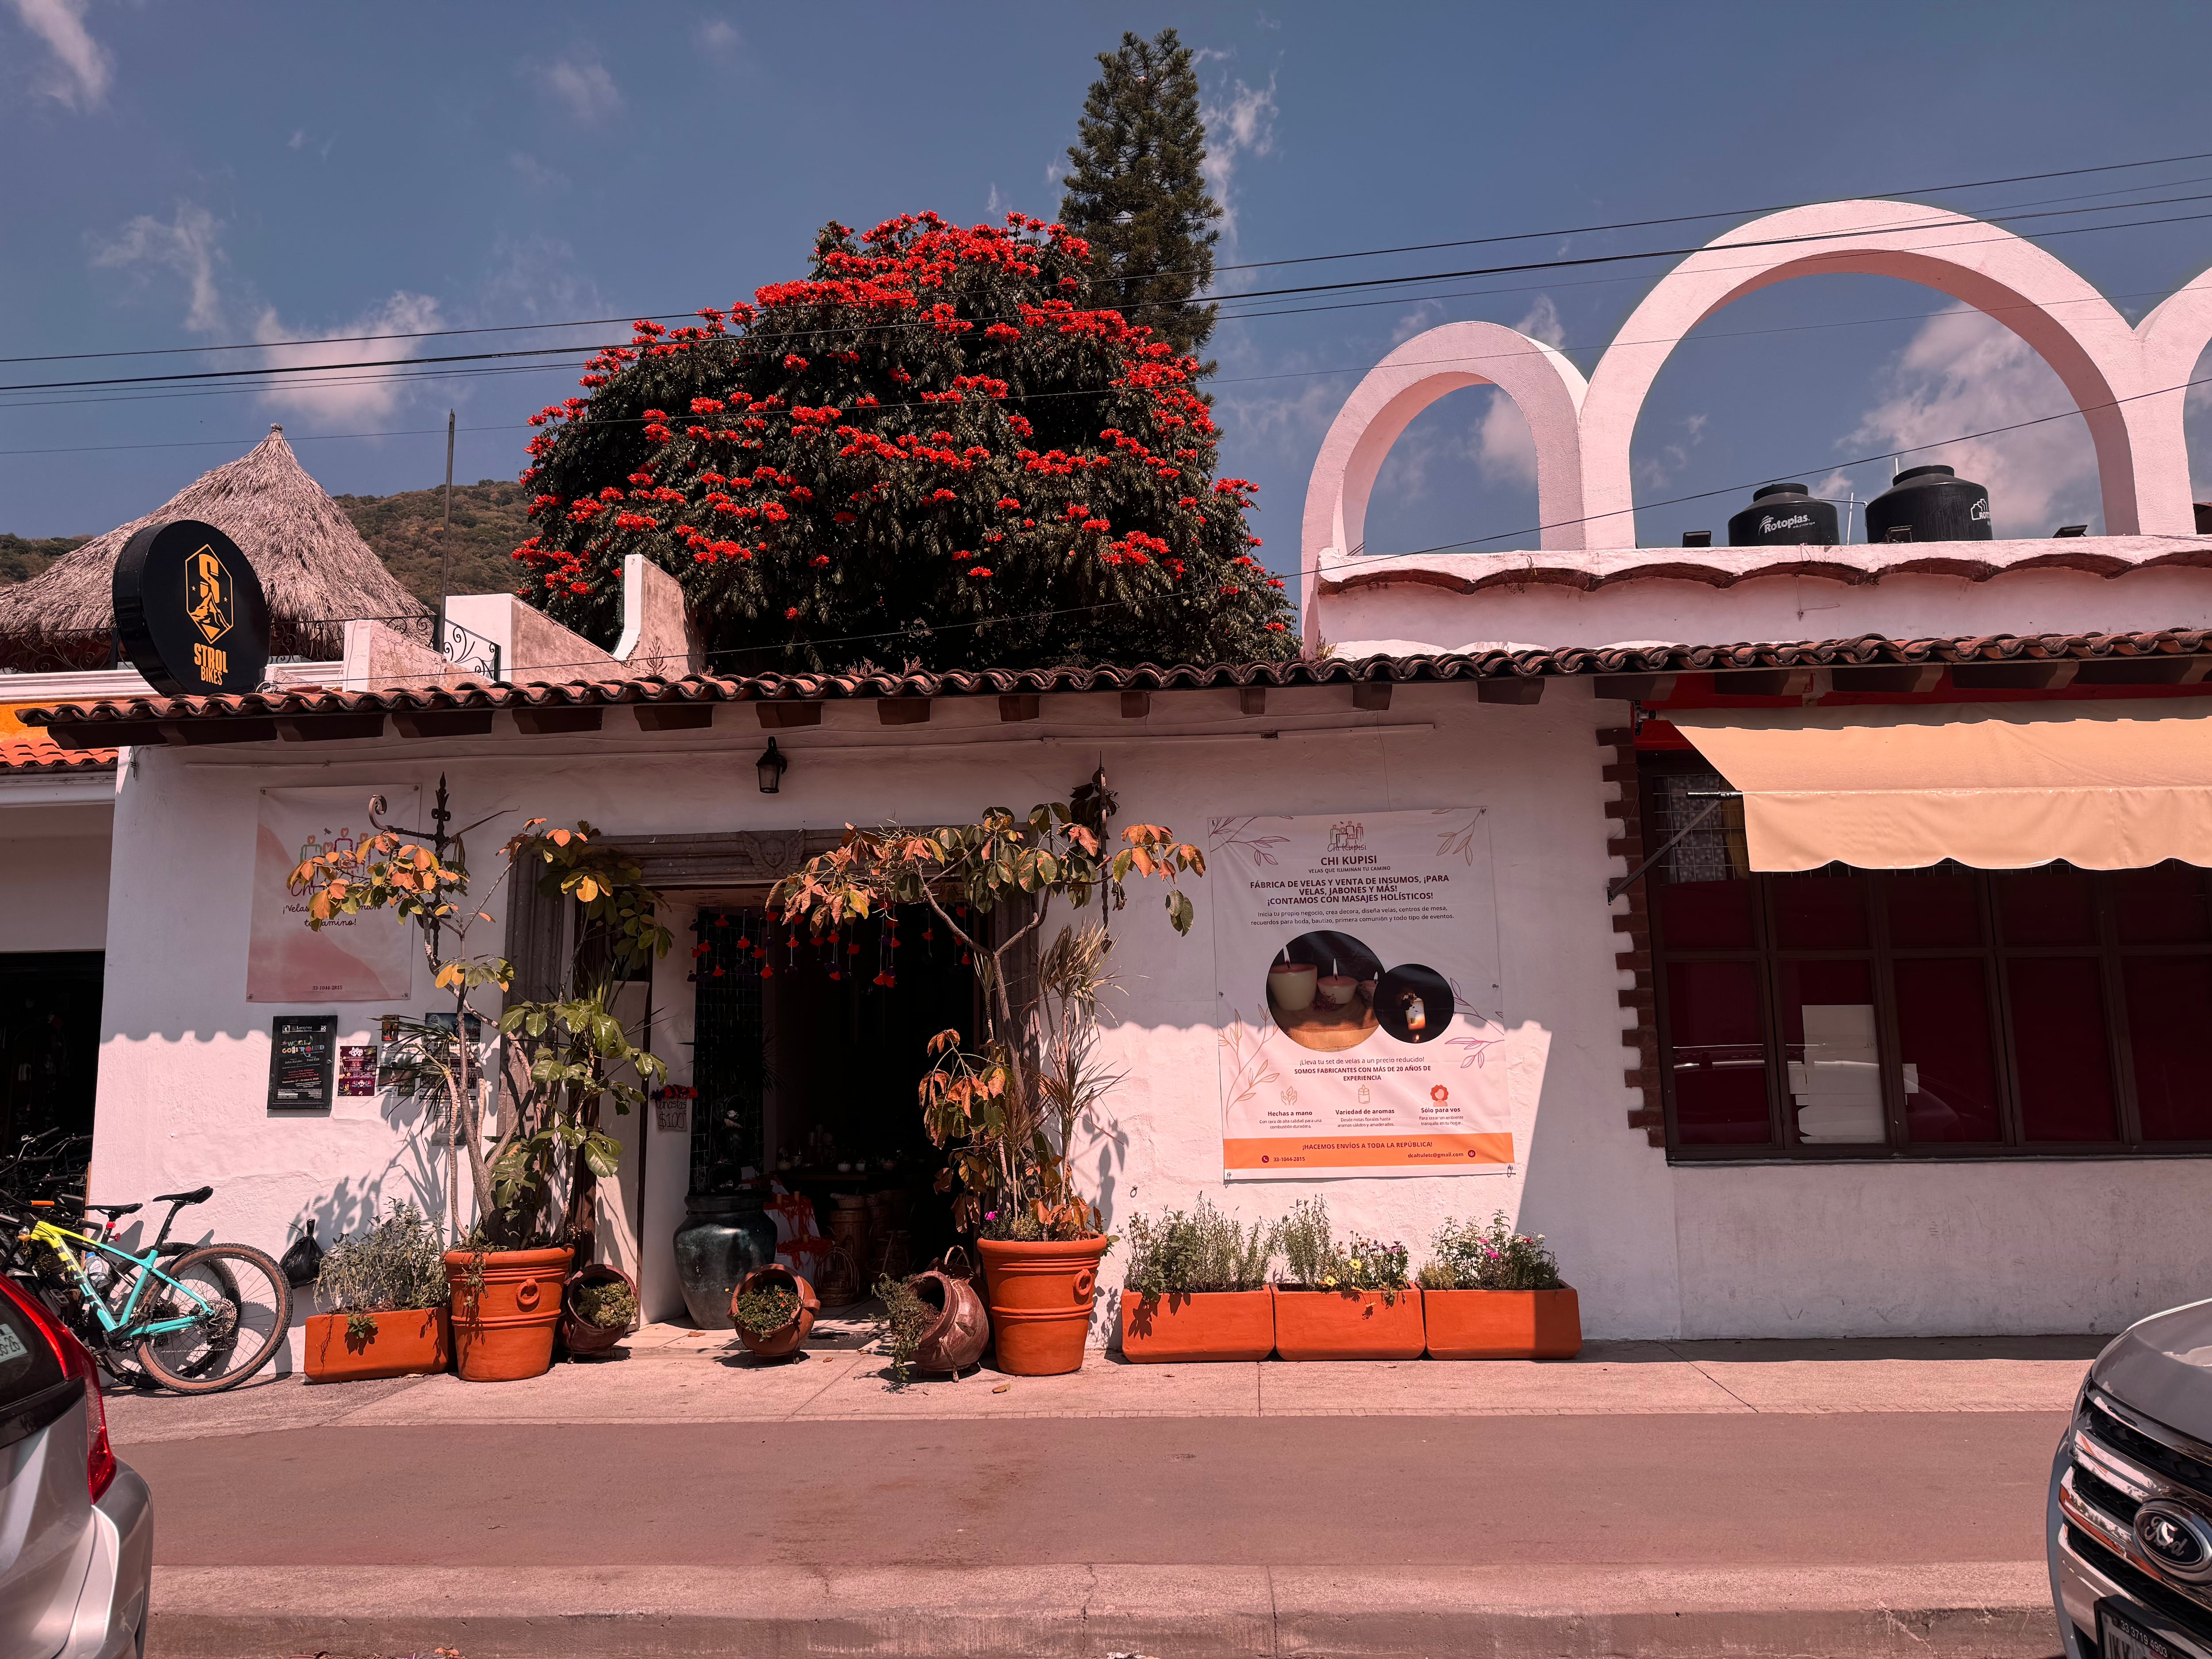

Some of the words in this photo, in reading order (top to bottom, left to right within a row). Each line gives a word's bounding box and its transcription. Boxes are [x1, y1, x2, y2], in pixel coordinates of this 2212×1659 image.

[194, 643, 228, 673] STROL
[201, 665, 223, 686] BIKES
[1321, 857, 1338, 865] CHI
[1342, 856, 1377, 865] KUPISI
[1424, 875, 1449, 883] ¡PARA
[1329, 887, 1366, 895] JABONES
[1268, 897, 1318, 906] ¡CONTAMOS
[1342, 895, 1378, 903] MASAJES
[1381, 892, 1433, 901] HOLÍSTICOS!
[283, 903, 309, 914] ¡Velas
[2120, 1620, 2130, 1633] 33
[2130, 1626, 2149, 1647] 3719
[2150, 1639, 2168, 1658] 4903
